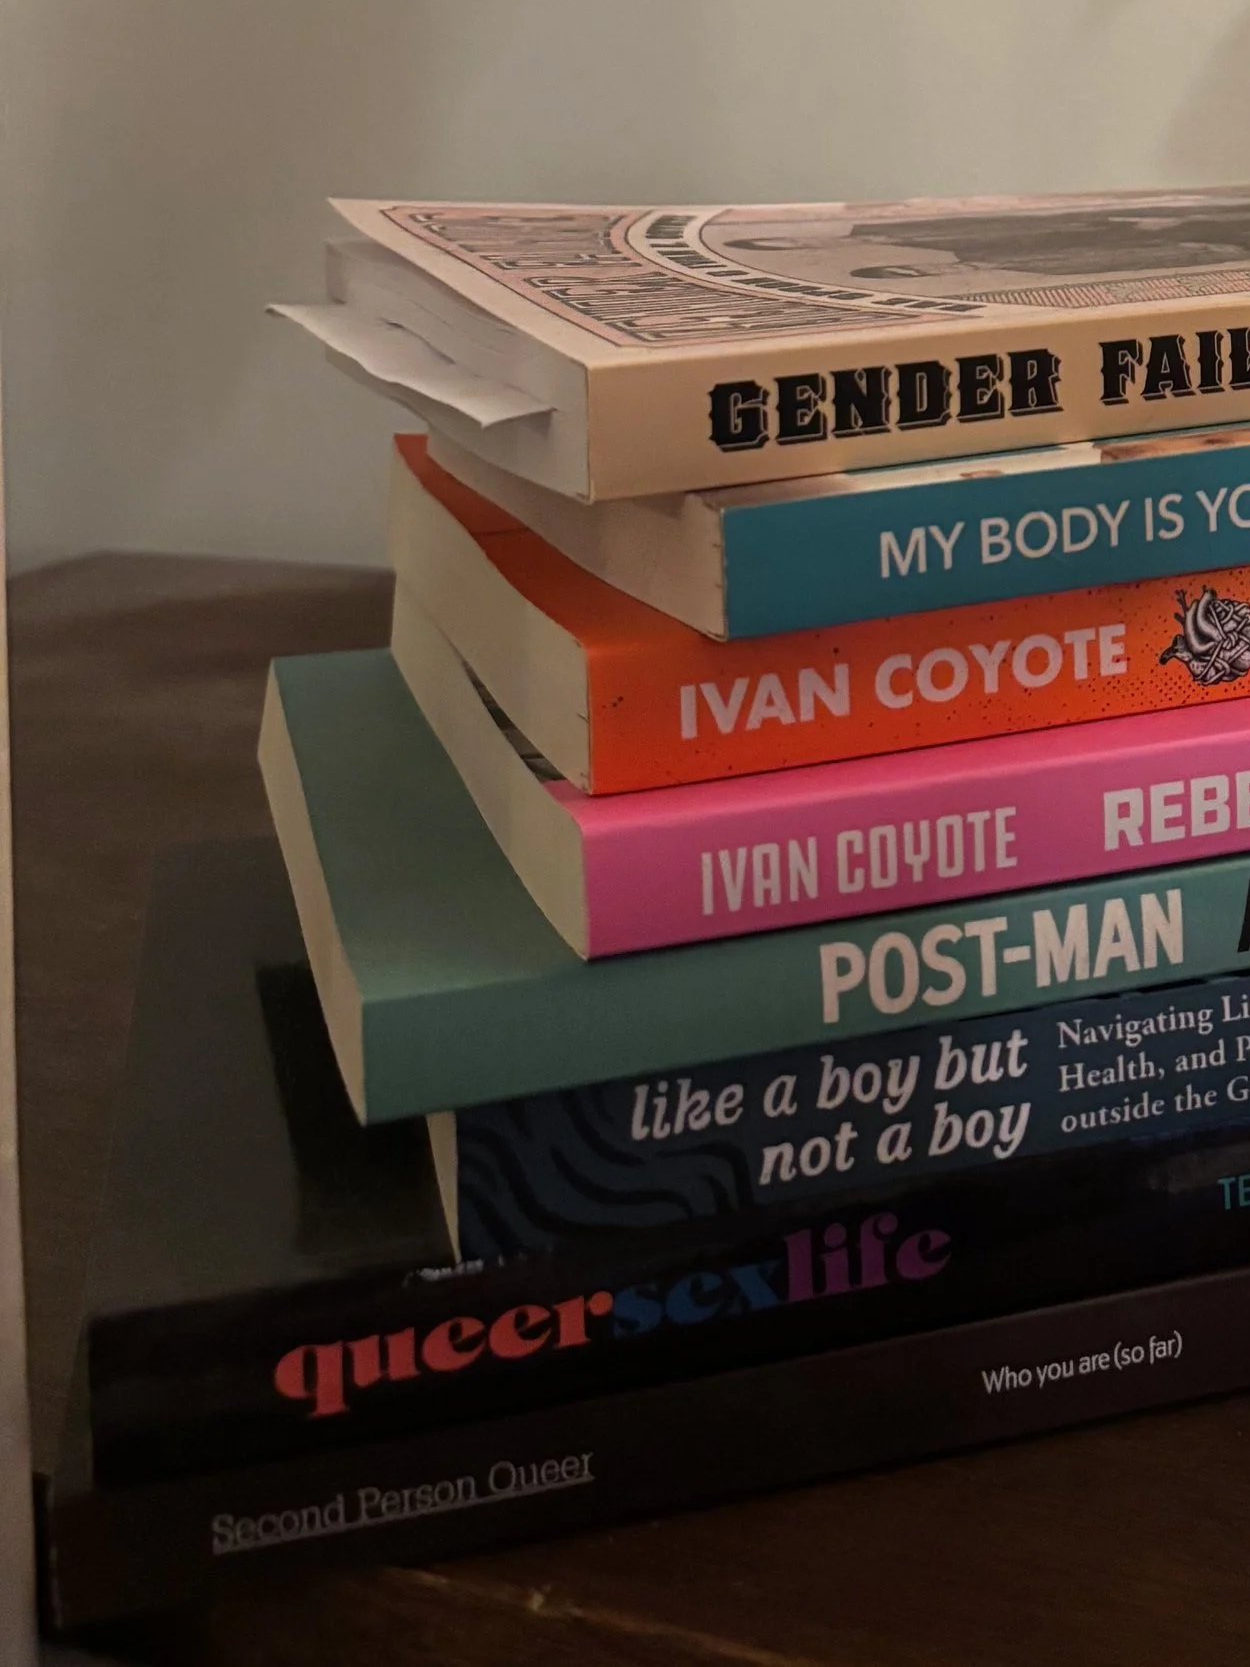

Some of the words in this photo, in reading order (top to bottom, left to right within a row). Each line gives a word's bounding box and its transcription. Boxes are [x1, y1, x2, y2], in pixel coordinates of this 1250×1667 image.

[709, 349, 1063, 452] GENDER
[880, 521, 965, 578] MY
[980, 500, 1130, 565] BODY
[1144, 493, 1184, 541] IS
[680, 663, 851, 740] IVAN
[875, 623, 1128, 709] COYOTE
[701, 836, 818, 915] IVAN
[836, 806, 1018, 894] COYOTE
[820, 888, 1184, 1024] POST-MAN
[1058, 1006, 1213, 1049] Navigating
[1058, 1055, 1165, 1092] Health,
[1175, 1039, 1226, 1073] and
[631, 1078, 744, 1141] like
[763, 1074, 798, 1118] a
[816, 1055, 920, 1115] boy
[934, 1029, 1028, 1091] but
[1060, 1092, 1165, 1133] outside
[1174, 1085, 1217, 1113] the
[759, 1122, 858, 1185] not
[877, 1121, 913, 1164] a
[928, 1101, 1031, 1159] boy
[274, 1212, 952, 1418] queersexlife
[981, 1365, 1032, 1394] Who
[1036, 1360, 1074, 1388] you
[1078, 1352, 1110, 1375] are
[1113, 1341, 1144, 1370] (so
[1150, 1330, 1182, 1364] far)
[212, 1494, 347, 1548] Second
[357, 1475, 477, 1522] Person
[489, 1452, 594, 1496] Queer
